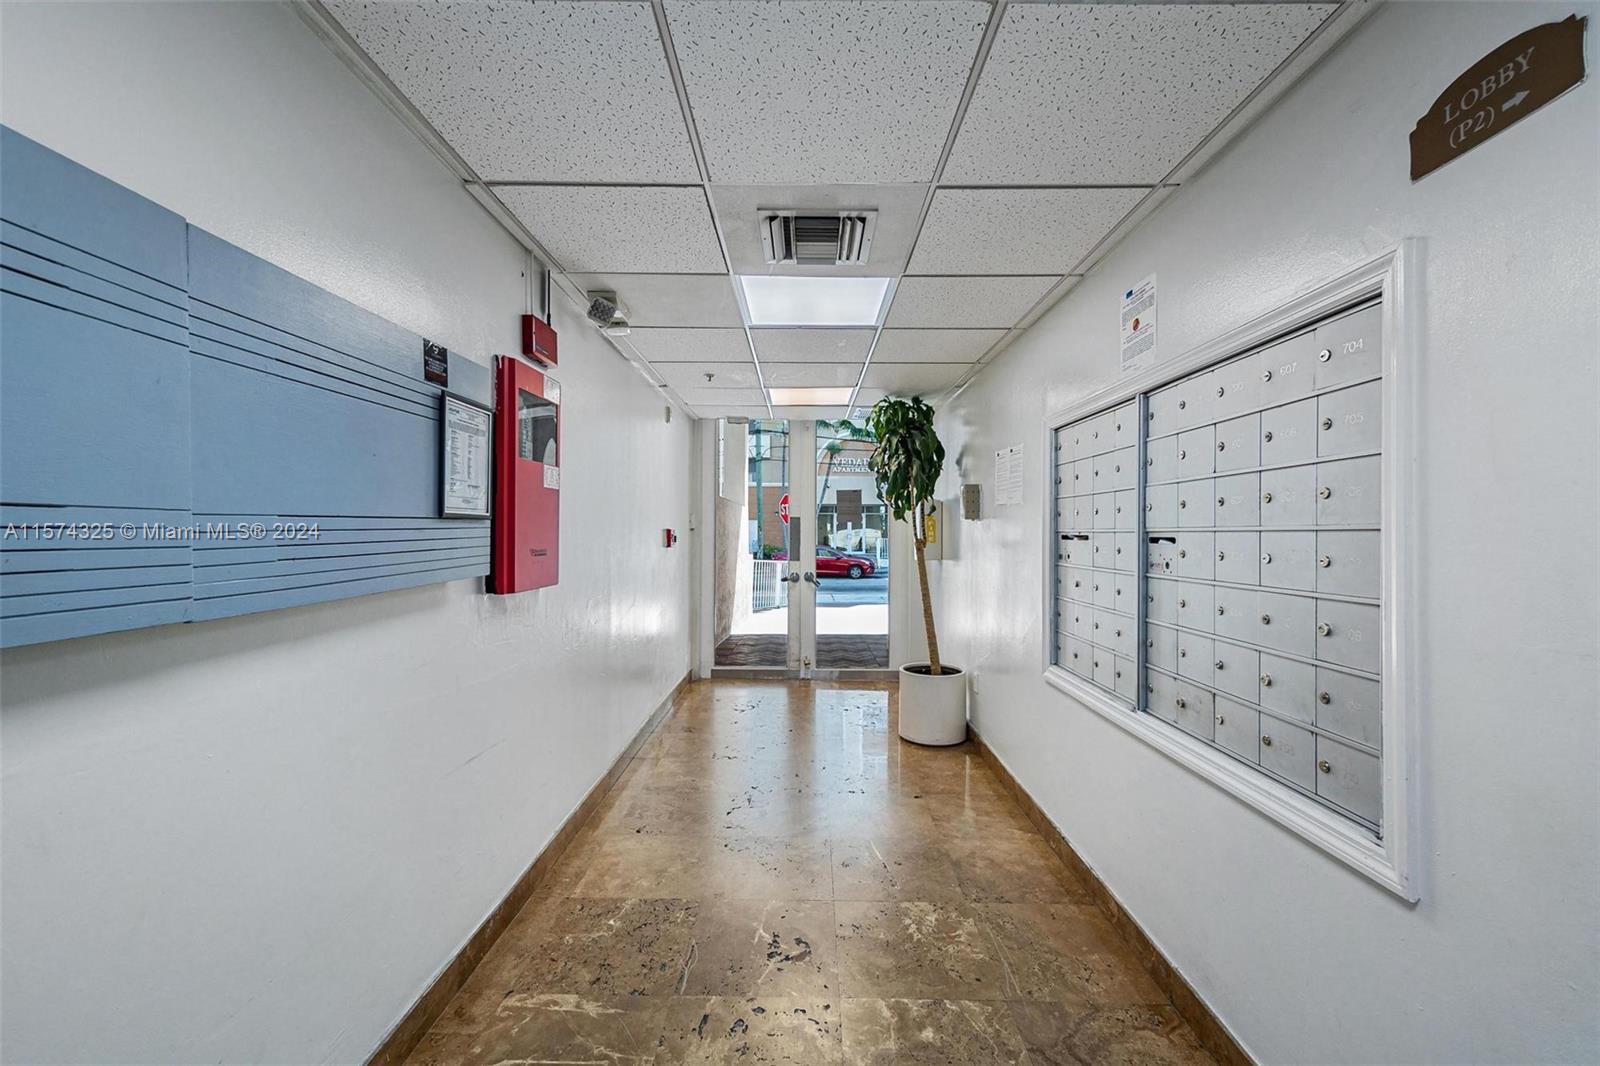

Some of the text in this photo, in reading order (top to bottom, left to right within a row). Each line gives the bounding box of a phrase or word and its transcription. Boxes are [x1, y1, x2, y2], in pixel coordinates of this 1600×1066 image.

[1443, 46, 1536, 124] LOBBY
[1450, 106, 1495, 148] (P2)
[1343, 338, 1364, 354] 704
[1279, 362, 1297, 377] 607
[780, 503, 789, 515] ST
